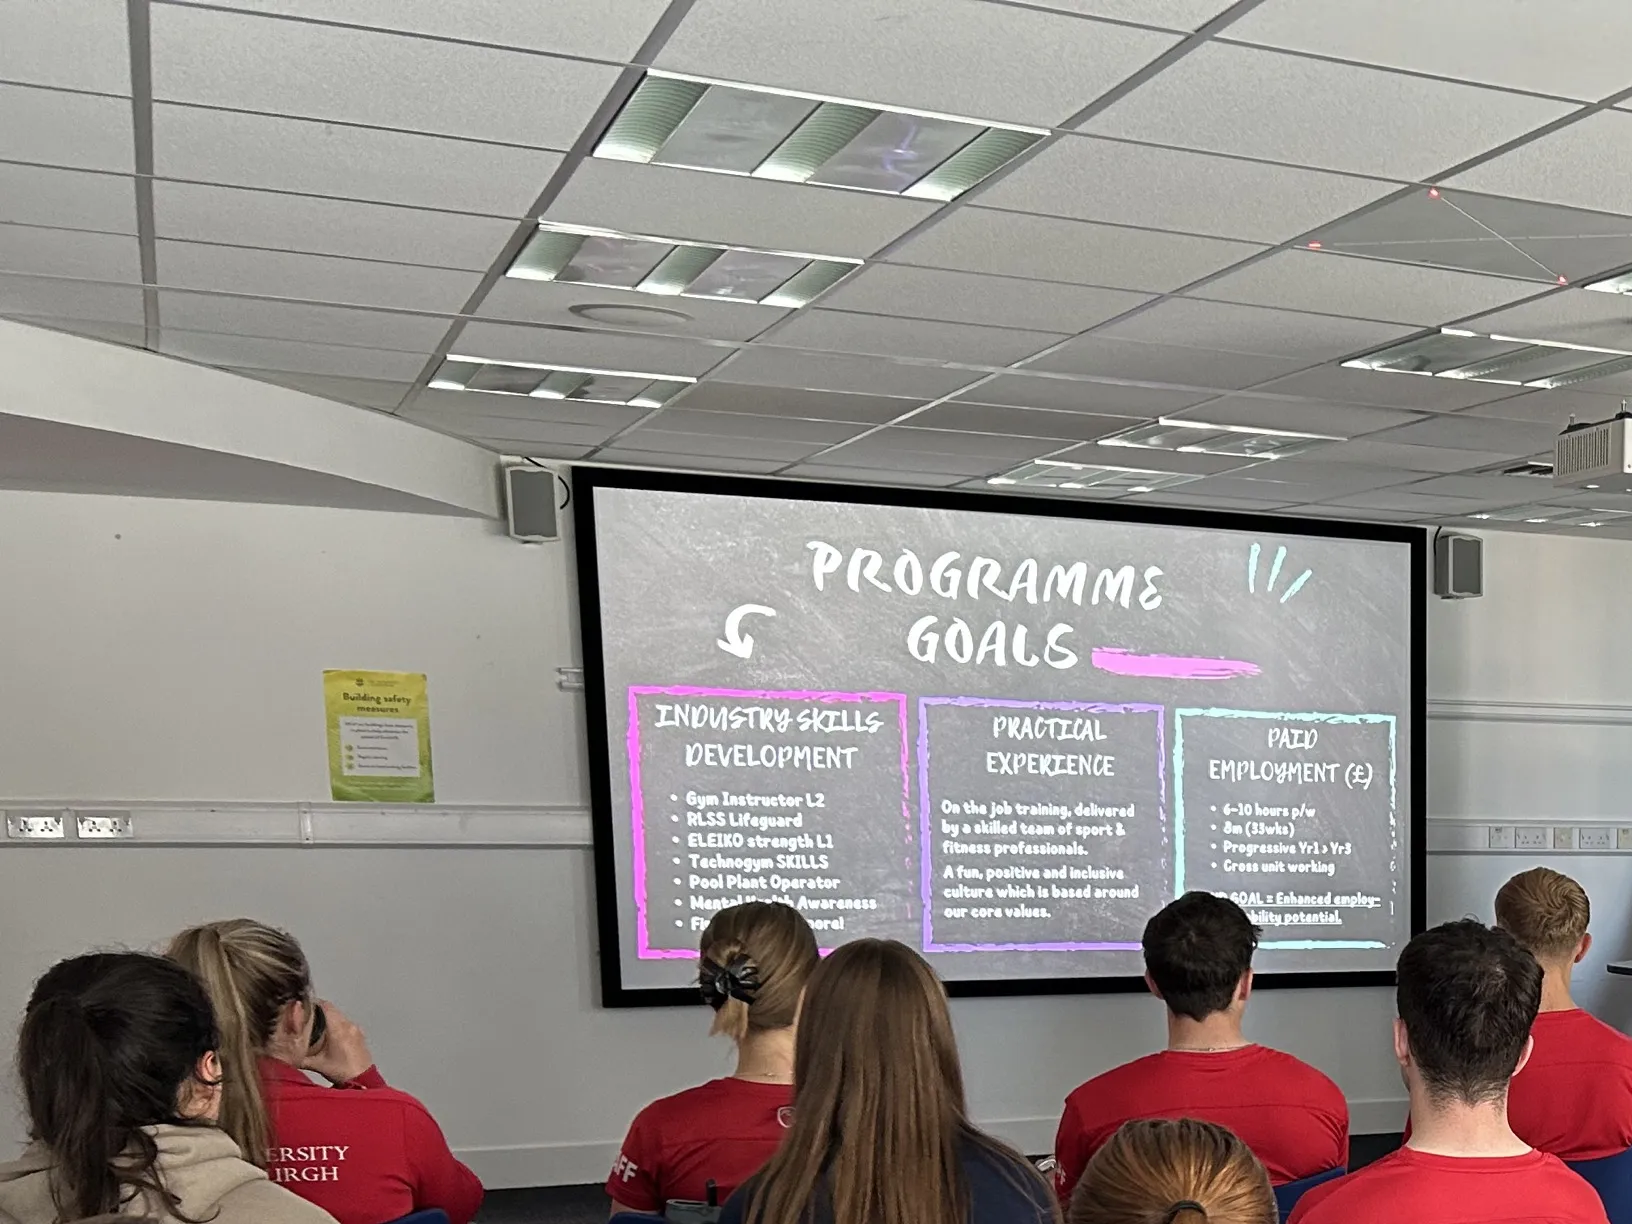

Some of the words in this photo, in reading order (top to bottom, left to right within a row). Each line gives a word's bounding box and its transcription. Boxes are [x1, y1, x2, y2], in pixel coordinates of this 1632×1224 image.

[806, 541, 1163, 610] PROGRAMME
[907, 615, 1078, 669] GOALS
[342, 692, 381, 704] Building
[383, 694, 410, 705] safety
[654, 703, 793, 732] INDUSTRY
[796, 708, 884, 733] SKILLS
[993, 716, 1107, 741] PRACTICAL
[1267, 727, 1318, 749] PAID
[685, 742, 858, 771] DEVELOPMENT
[986, 751, 1115, 776] EXPERIENCE
[1208, 759, 1340, 784] EMPLOYMENT
[1344, 762, 1373, 789] (£)
[685, 791, 718, 809] Gym
[722, 791, 802, 807] Instructor
[805, 792, 825, 807] L2
[941, 800, 960, 814] On
[963, 800, 986, 815] the
[989, 801, 1012, 818] job
[1014, 802, 1072, 819] training,
[1074, 802, 1135, 817] delivered
[1223, 803, 1252, 816] 6-10
[1255, 803, 1289, 817] hours
[1291, 804, 1316, 819] p/w
[687, 812, 726, 827] RLSS
[729, 812, 802, 831] Lifeguard
[941, 819, 959, 837] by
[962, 823, 971, 835] a
[974, 820, 1017, 835] skilled
[1019, 822, 1054, 836] team
[1057, 821, 1072, 835] of
[1075, 822, 1113, 839] sport
[1115, 822, 1126, 836] &
[1223, 822, 1242, 835] 8m
[1245, 822, 1295, 837] (33wks)
[687, 832, 743, 847] ELEIKO
[746, 833, 813, 851] strength
[816, 834, 833, 848] L1
[942, 840, 991, 854] fitness
[994, 841, 1088, 857] professionals.
[1223, 840, 1296, 856] Progressive
[1298, 841, 1319, 854] Yr1
[1330, 841, 1352, 855] Yr3
[688, 853, 773, 872] Technogym
[776, 854, 828, 869] SKILLS
[1223, 859, 1258, 872] Cross
[1261, 860, 1285, 873] unit
[1287, 860, 1336, 876] working
[942, 864, 955, 879] A
[956, 864, 983, 881] fun,
[986, 866, 1040, 883] positive
[1043, 865, 1067, 880] and
[1069, 866, 1124, 880] inclusive
[688, 874, 722, 889] Pool
[726, 874, 767, 889] Plant
[769, 875, 840, 892] Operator
[943, 884, 993, 898] culture
[996, 884, 1035, 899] which
[1038, 885, 1049, 898] is
[1051, 884, 1091, 899] based
[1093, 885, 1139, 899] around
[796, 895, 877, 910] Awareness
[1276, 891, 1331, 905] Enhanced
[943, 905, 968, 918] our
[970, 906, 1002, 918] core
[1005, 903, 1051, 919] values.
[1247, 910, 1281, 926] bility
[1284, 909, 1342, 926] potential.
[264, 1145, 350, 1162] ERSITY
